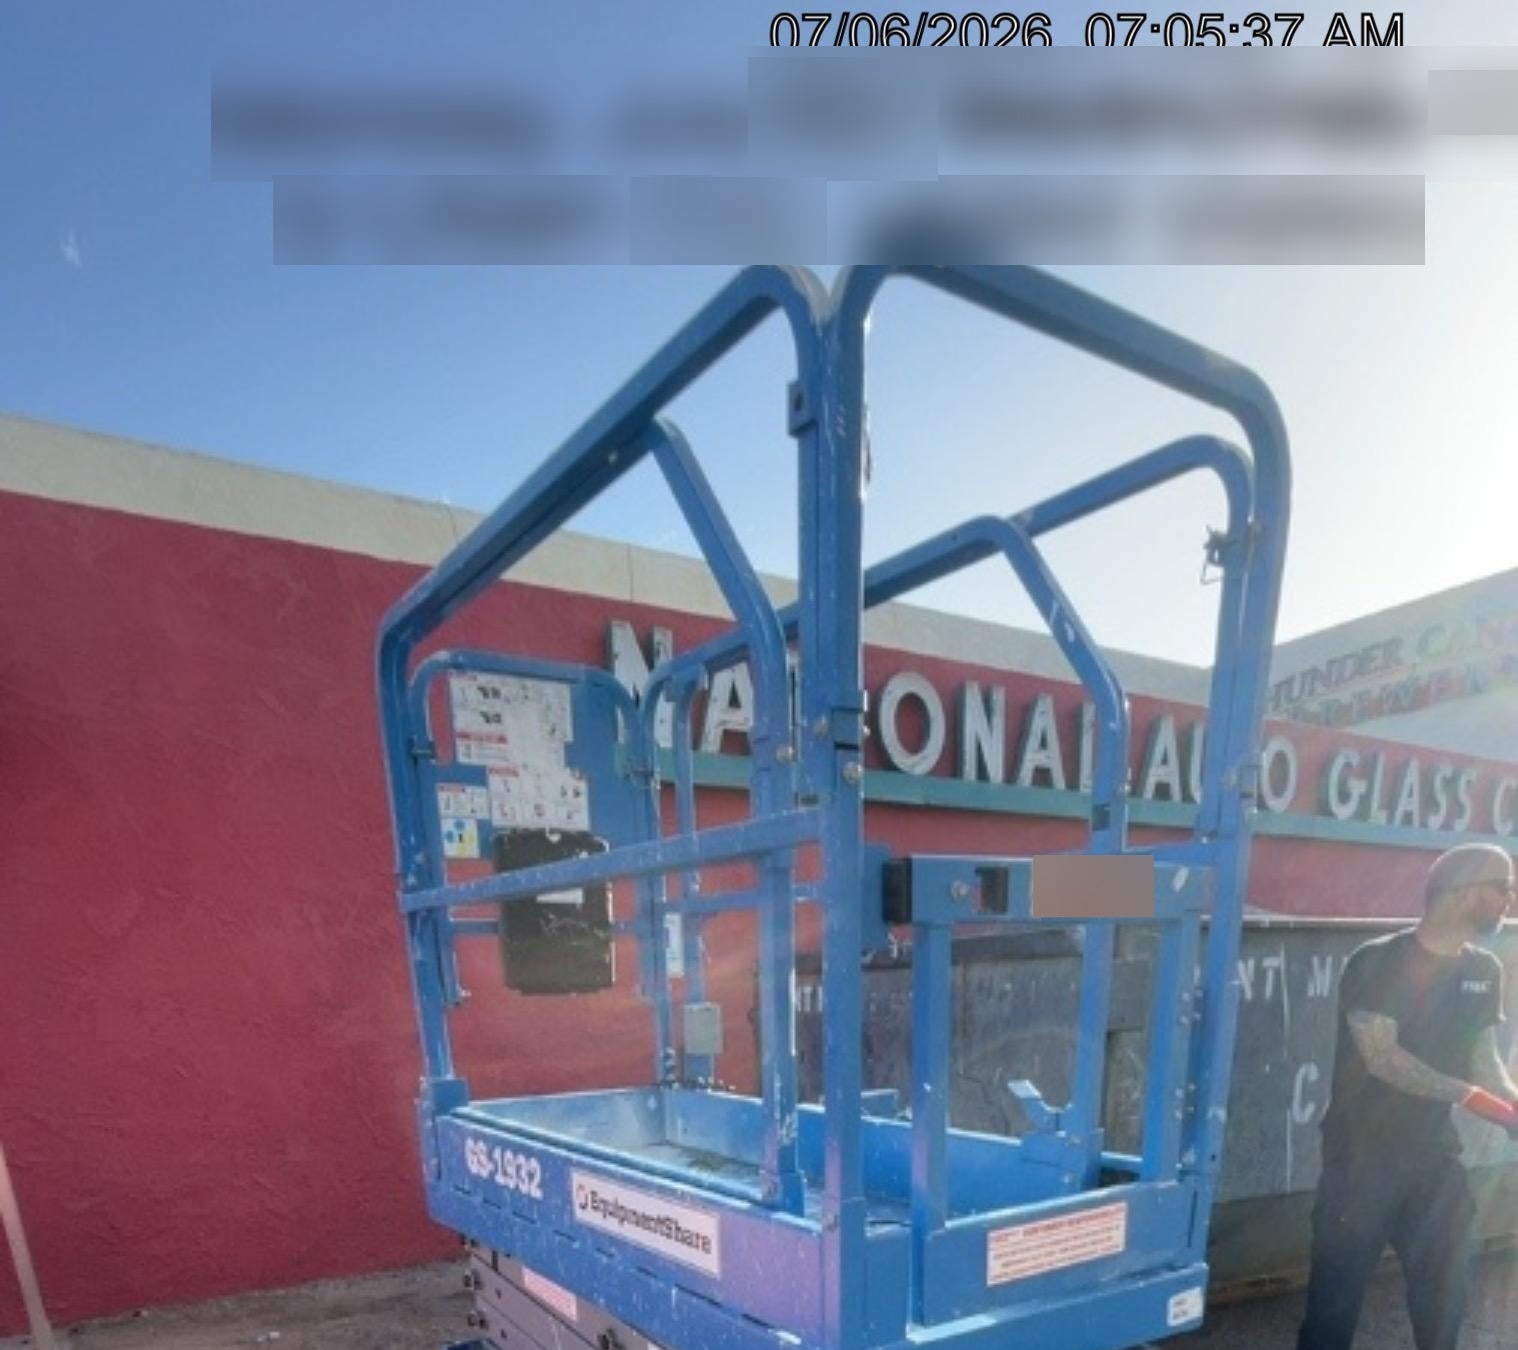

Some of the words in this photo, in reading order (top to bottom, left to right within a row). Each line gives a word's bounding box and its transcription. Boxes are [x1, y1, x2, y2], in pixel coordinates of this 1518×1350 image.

[1328, 747, 1479, 832] GLASS
[464, 1135, 544, 1201] GS-1932
[589, 1188, 713, 1256] EquipmentShare
